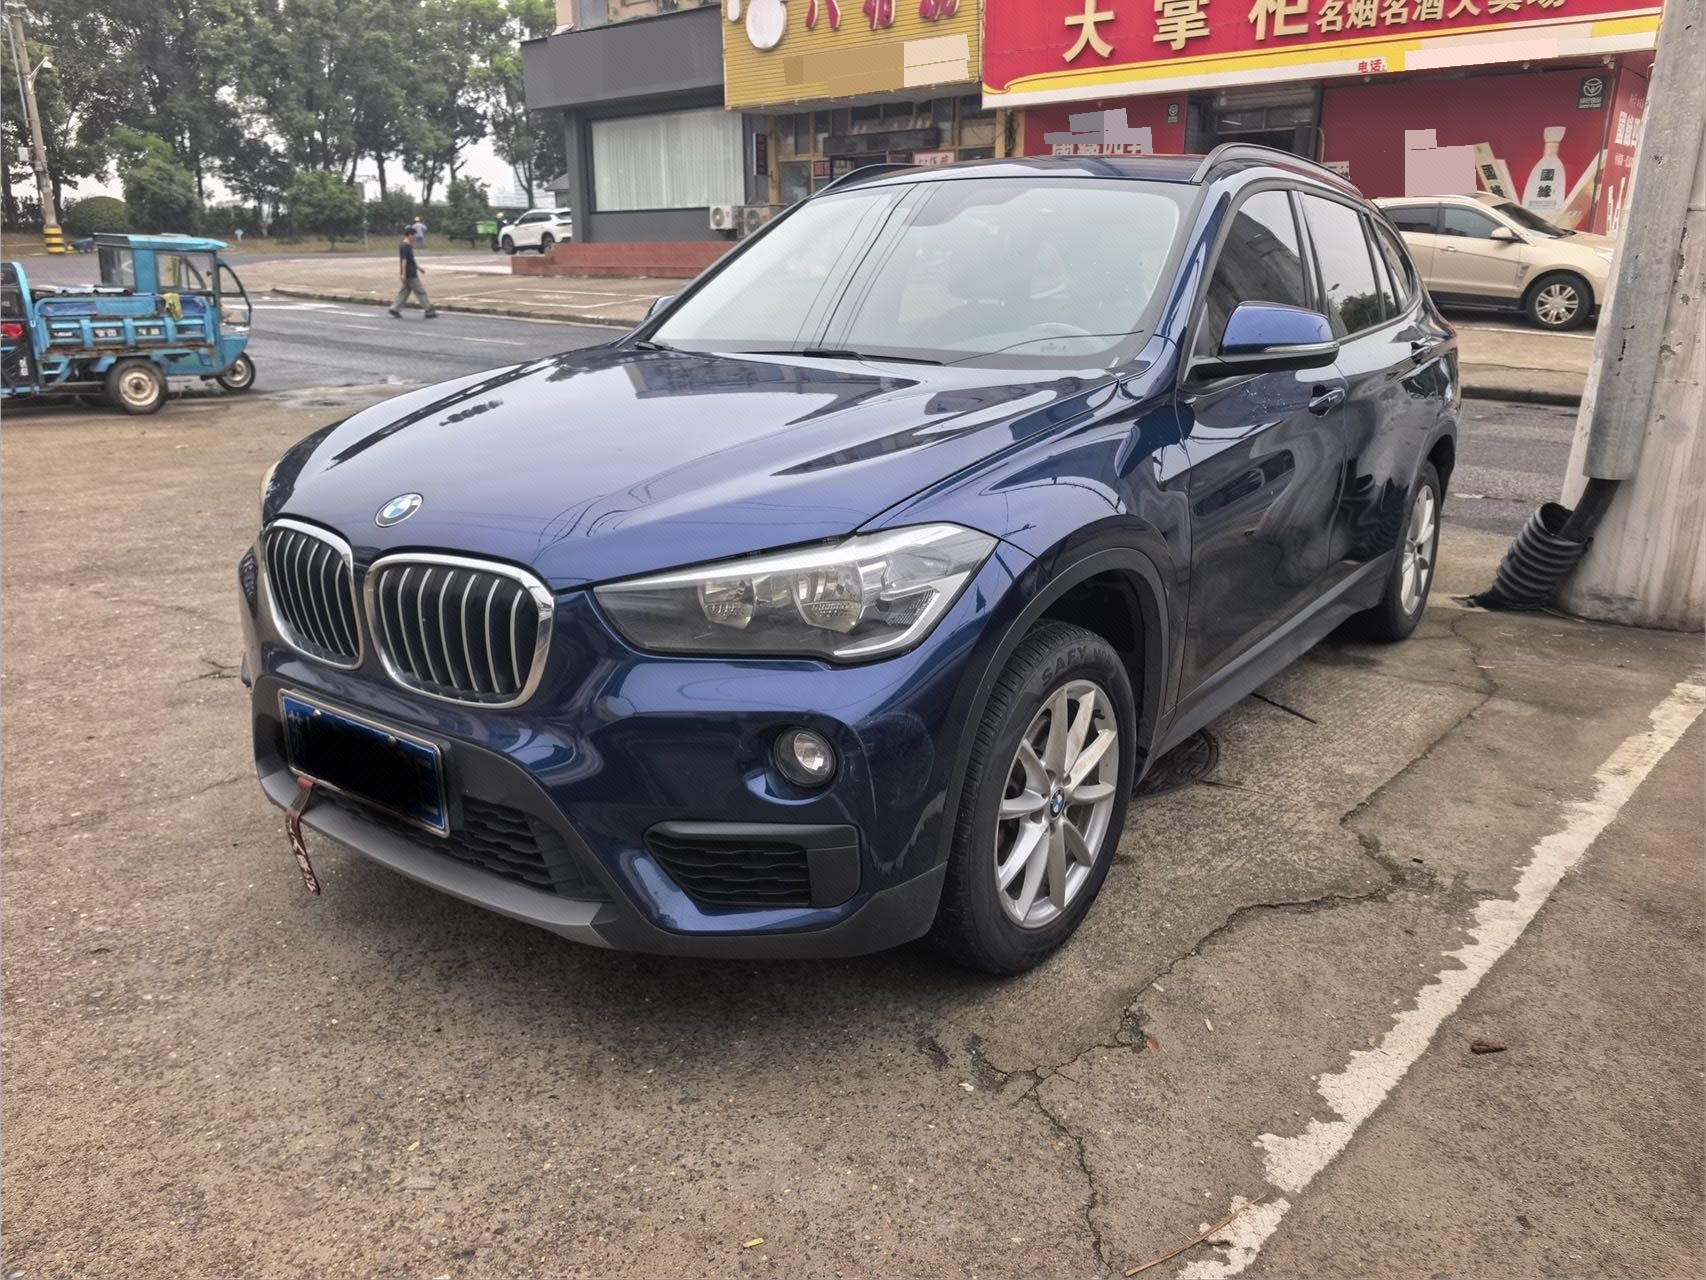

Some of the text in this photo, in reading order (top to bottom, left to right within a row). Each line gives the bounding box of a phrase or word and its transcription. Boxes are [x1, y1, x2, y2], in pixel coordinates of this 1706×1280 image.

[1062, 0, 1565, 63] 大掌柜 名烟名酒
